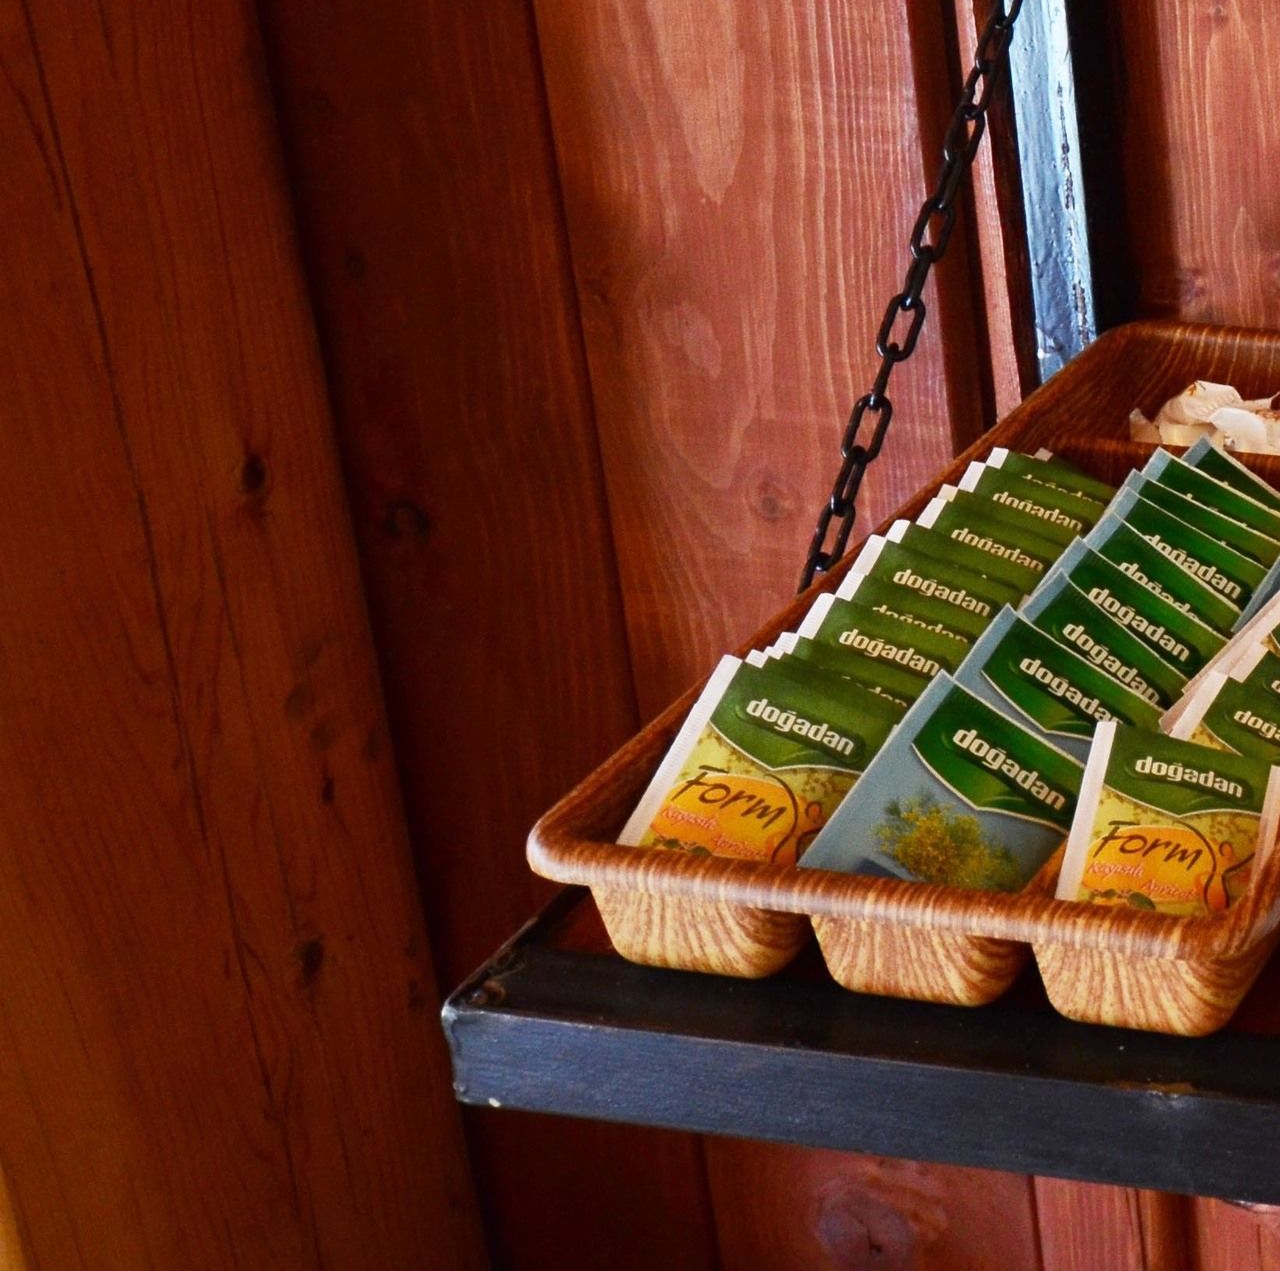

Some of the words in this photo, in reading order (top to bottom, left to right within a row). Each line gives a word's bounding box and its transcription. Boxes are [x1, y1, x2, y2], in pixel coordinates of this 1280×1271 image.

[892, 569, 991, 617] doğadan
[838, 628, 941, 676] doğadan
[1088, 587, 1190, 662] doğadan
[1019, 657, 1124, 724] doğada
[746, 698, 855, 756] doğadan
[671, 764, 788, 830] Form
[952, 728, 1067, 810] doğadan
[1134, 755, 1243, 798] doğadan
[1092, 820, 1203, 872] Form
